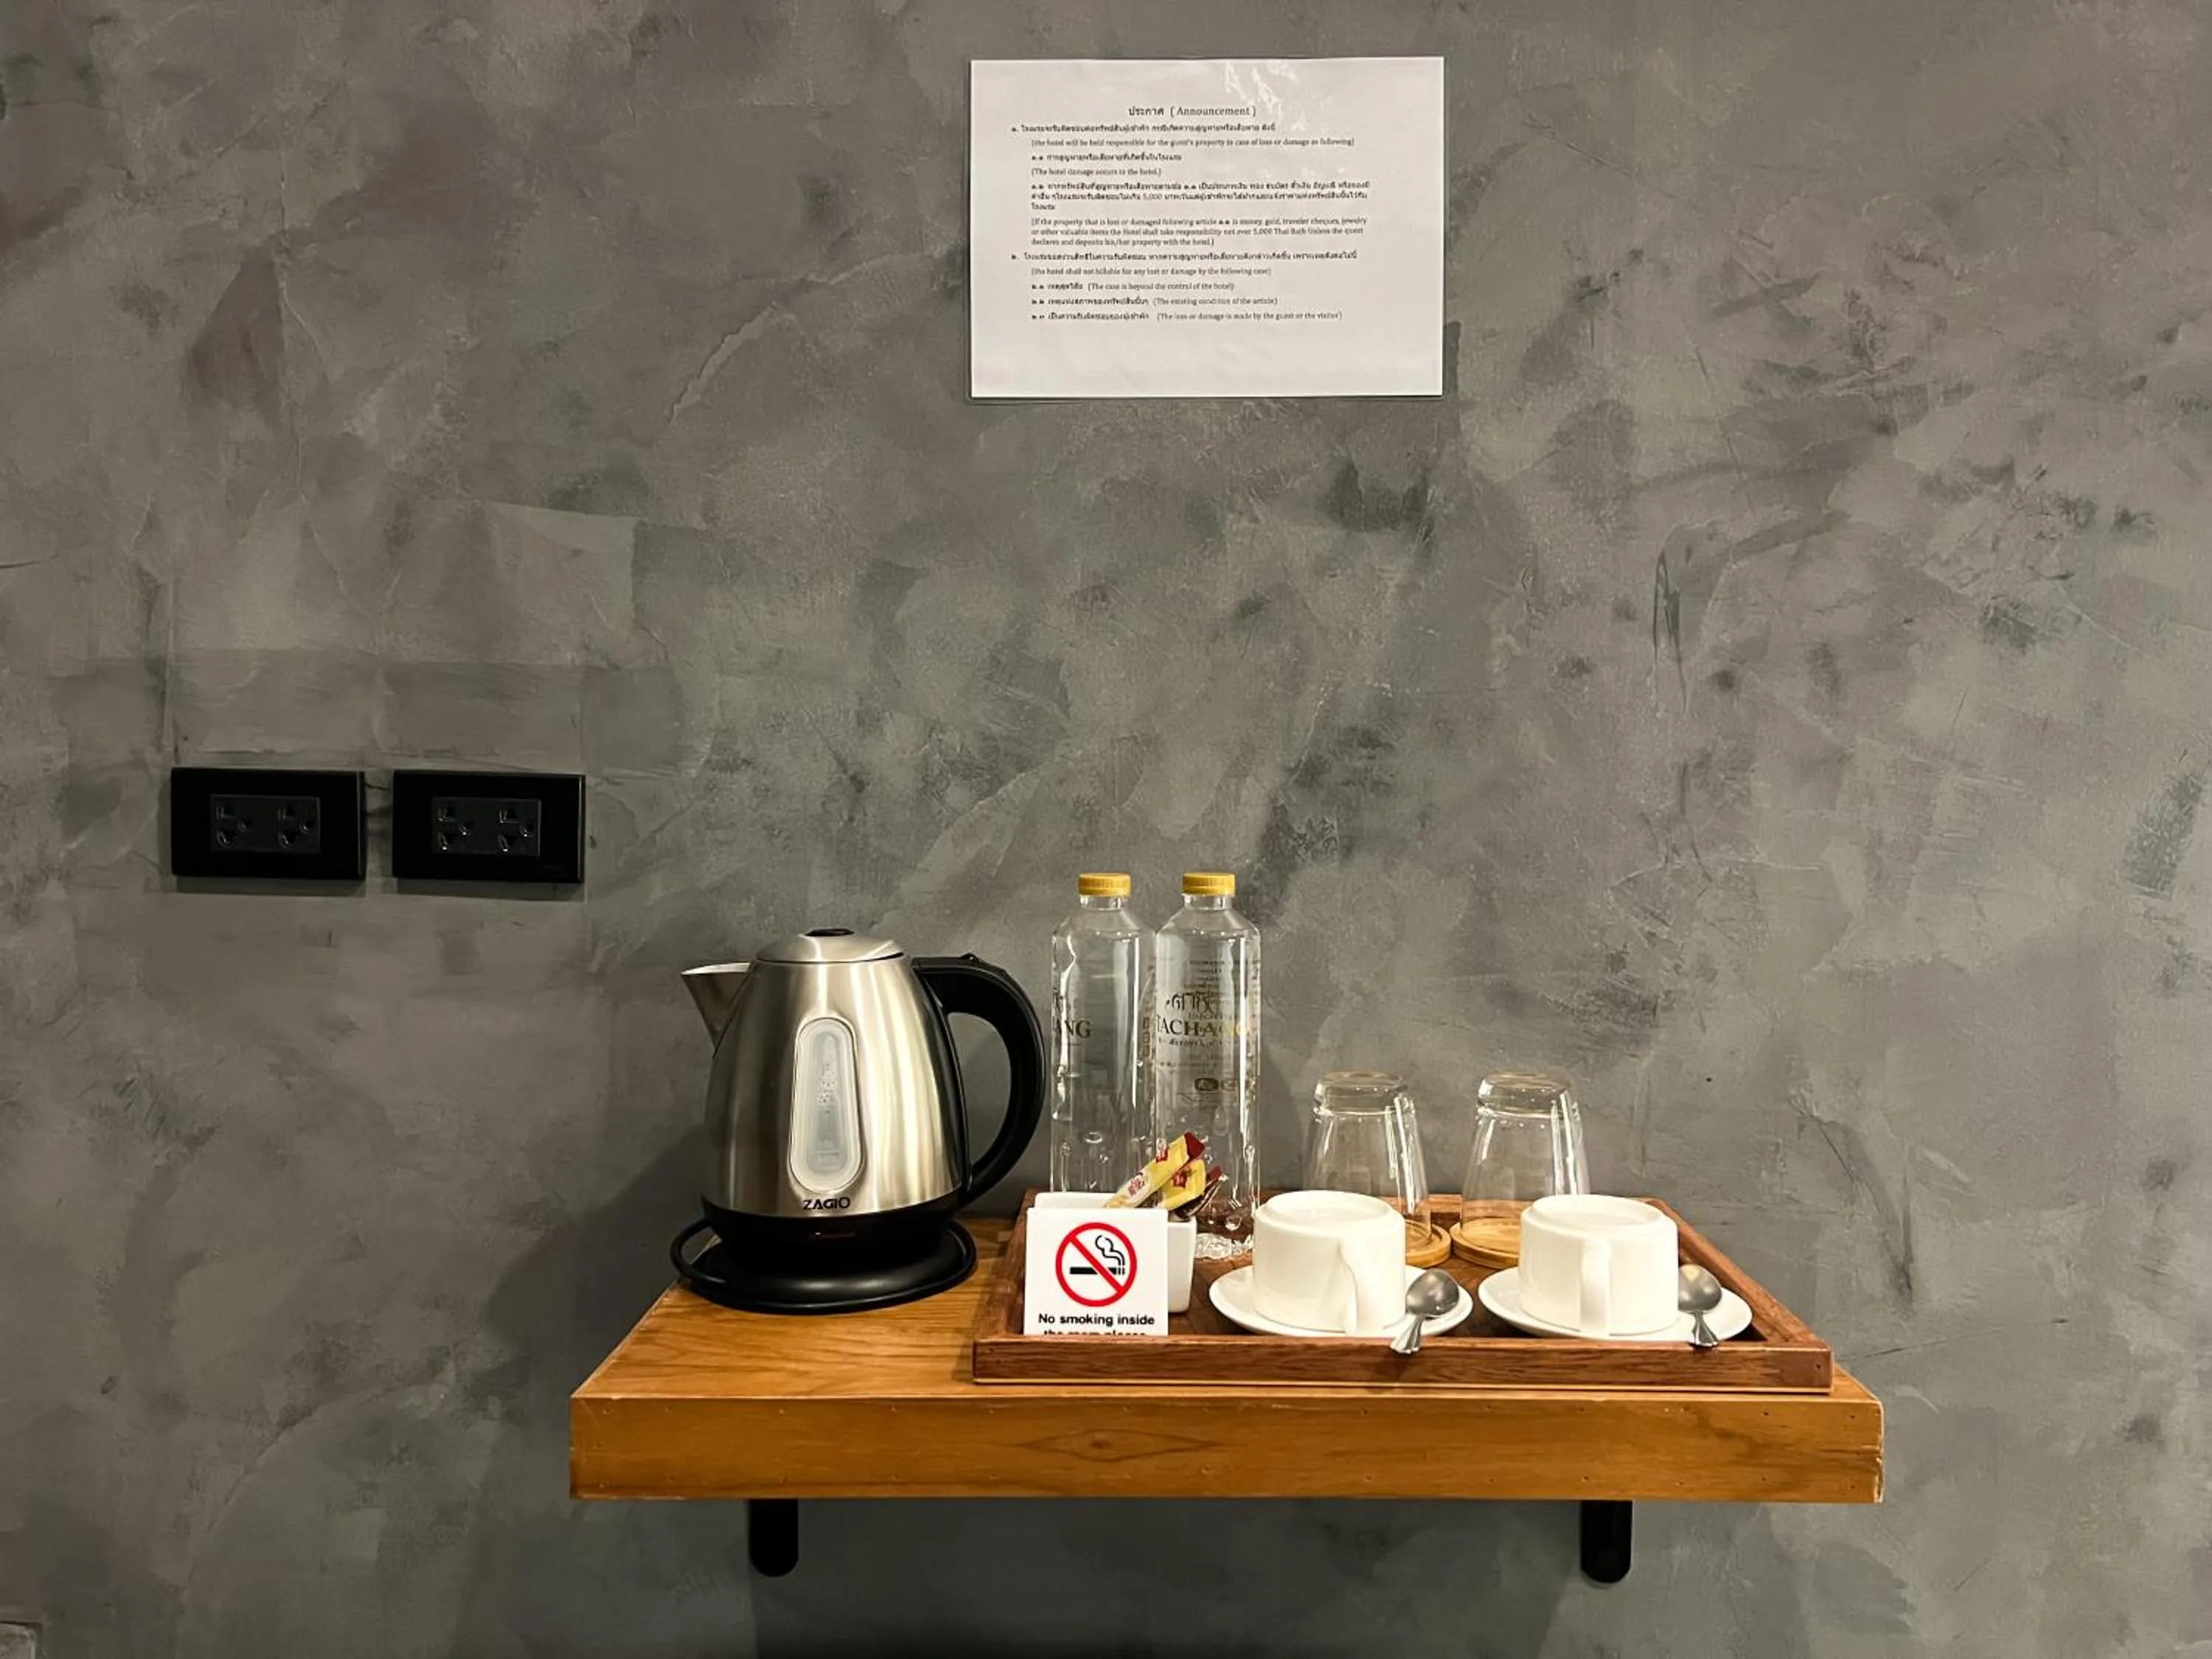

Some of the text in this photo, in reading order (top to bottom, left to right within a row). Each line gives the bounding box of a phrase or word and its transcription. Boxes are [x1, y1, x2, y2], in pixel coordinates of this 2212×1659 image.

[1127, 107, 1164, 116] ประกาศ
[1067, 169, 1093, 177] damage
[1162, 218, 1194, 226] following
[1198, 268, 1207, 276] by
[1220, 267, 1253, 276] following
[1253, 313, 1262, 321] by
[803, 1197, 850, 1210] ZAGIO
[1038, 1313, 1155, 1327] No smoking inside
